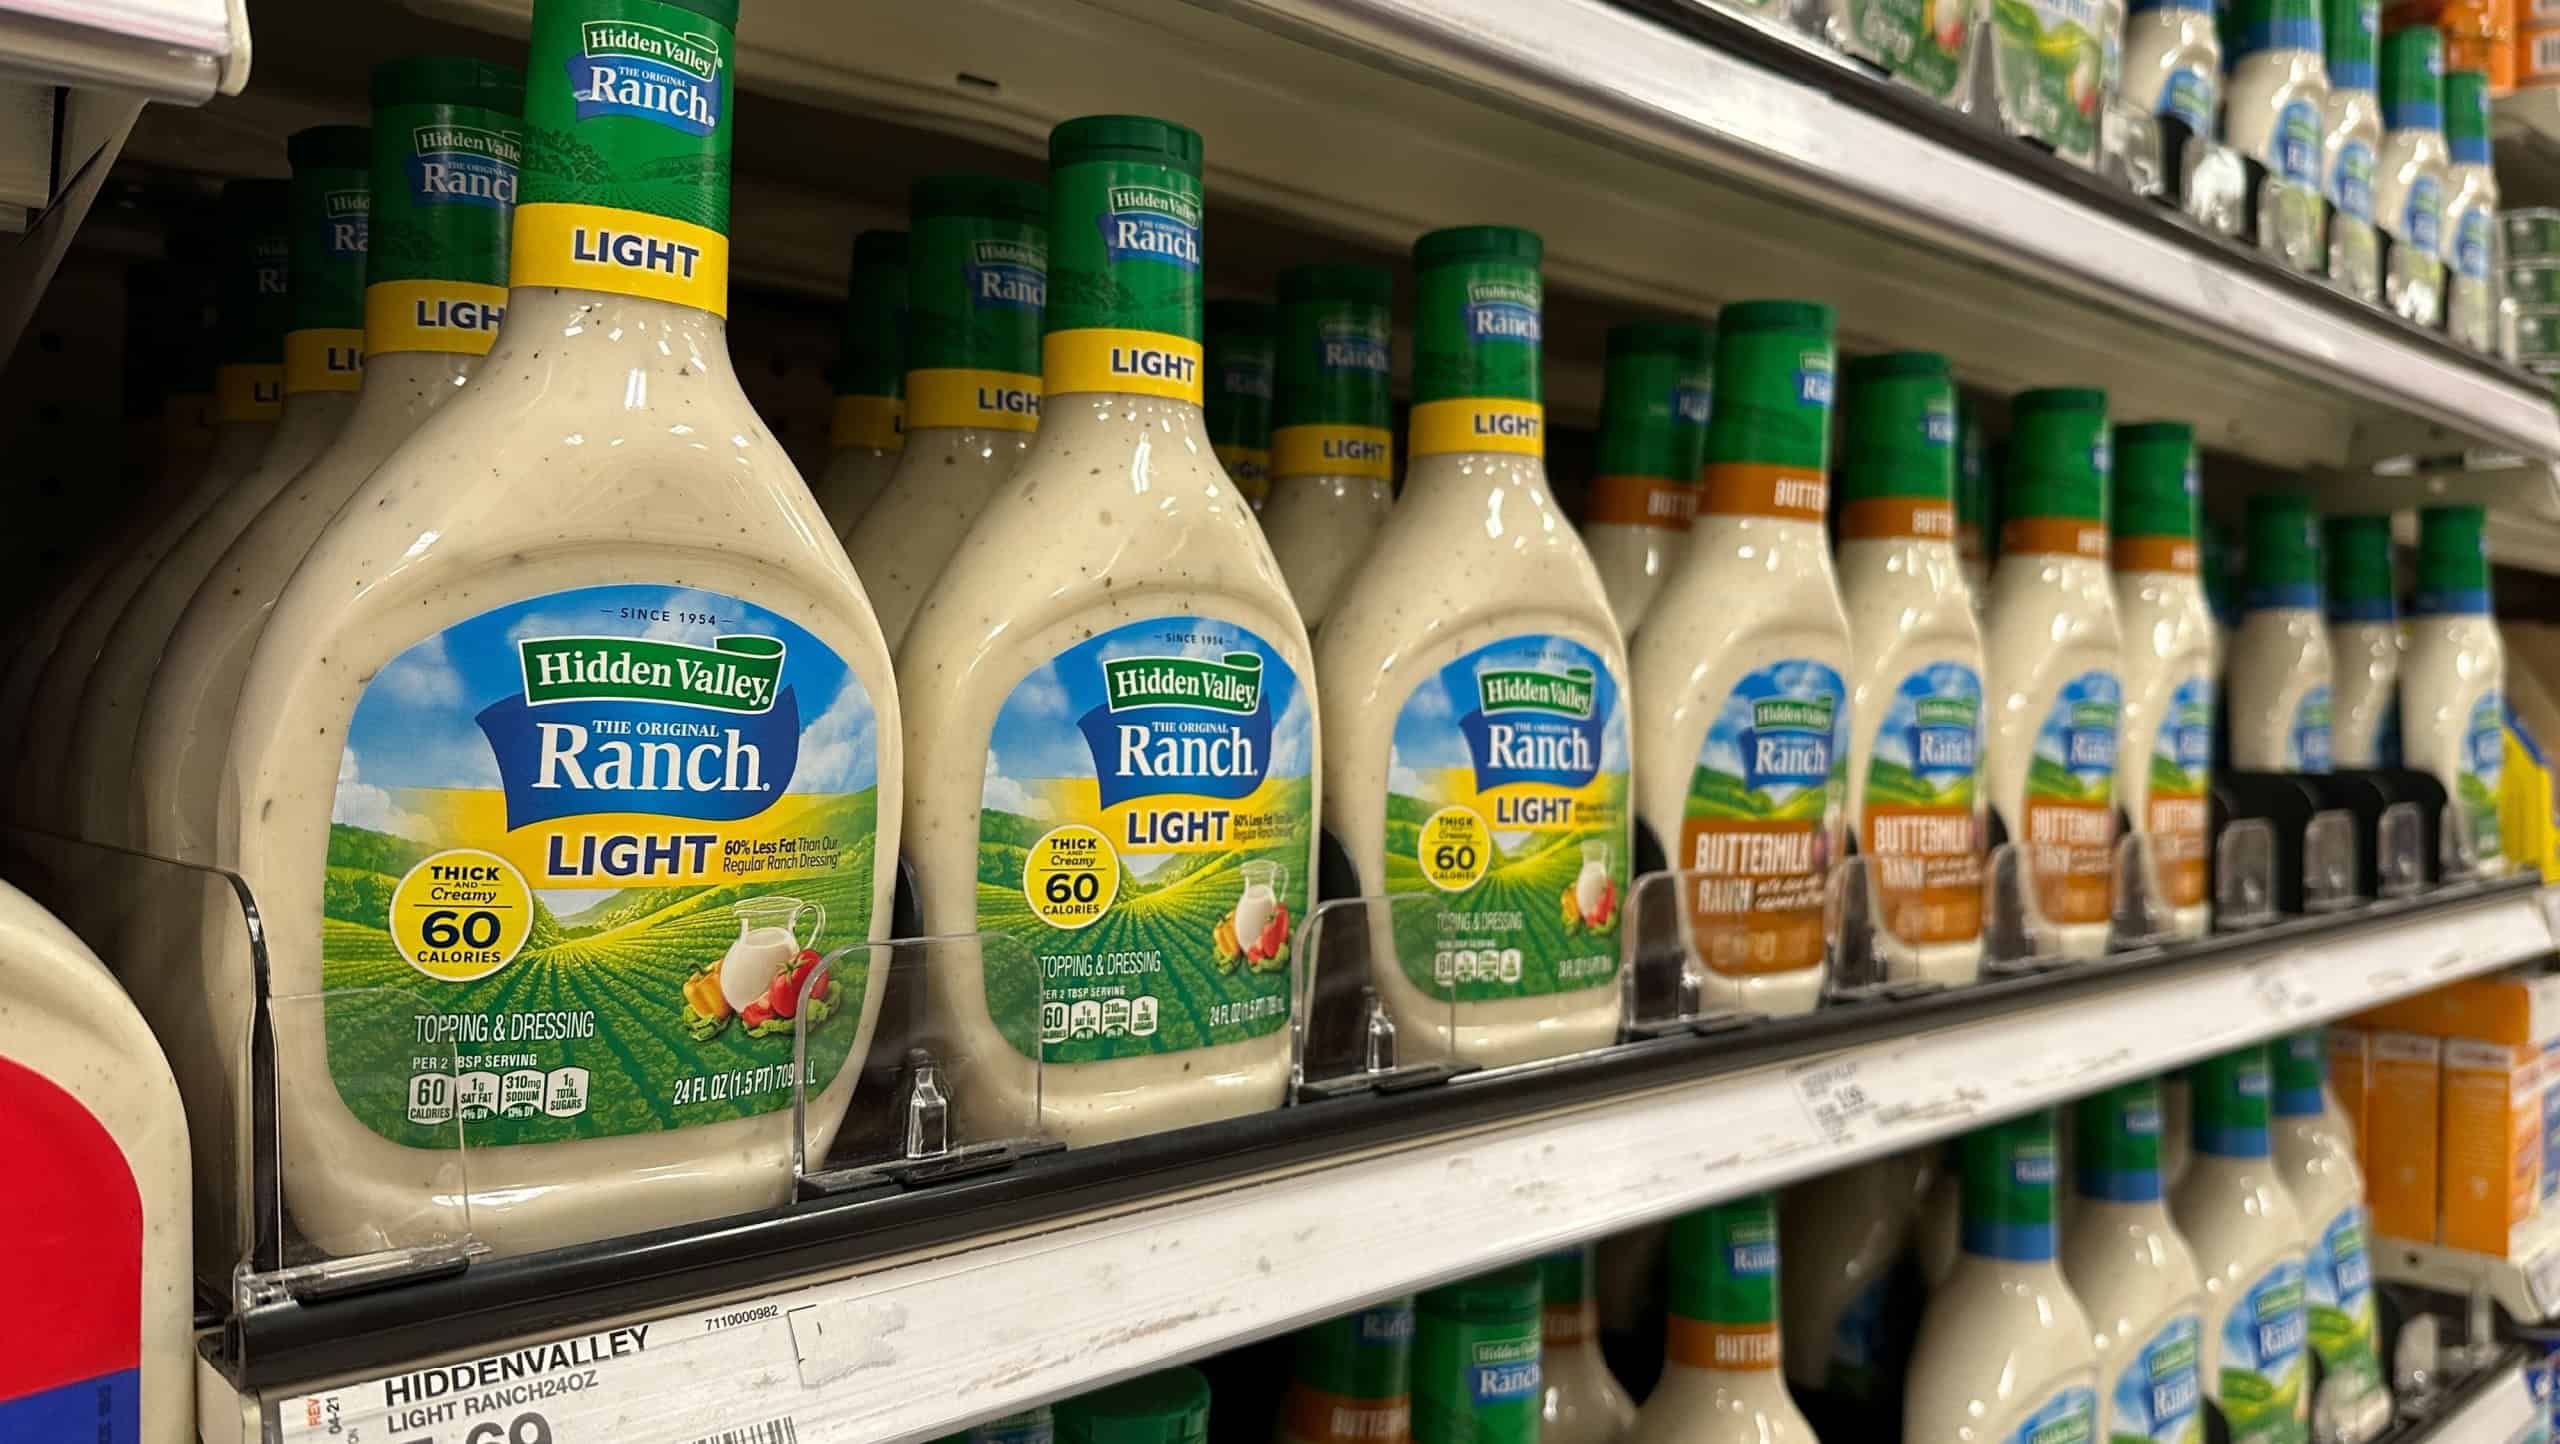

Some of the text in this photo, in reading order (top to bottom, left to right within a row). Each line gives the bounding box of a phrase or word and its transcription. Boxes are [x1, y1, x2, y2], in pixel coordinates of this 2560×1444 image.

[589, 29, 713, 76] Hidden Valley
[618, 65, 688, 88] THE ORIGINAL
[588, 65, 711, 126] Ranch
[421, 130, 520, 162] Hidden Valle
[1116, 191, 1169, 211] Hidden
[573, 228, 700, 278] LIGHT
[1115, 219, 1197, 264] Ranch
[416, 299, 506, 331] LIGH
[1111, 347, 1196, 384] LIGHT
[978, 387, 1041, 415] LIGH
[1473, 412, 1539, 439] LIGHT
[620, 607, 717, 626] SINCE 1954
[535, 650, 769, 706] Hidden Valley
[1115, 667, 1255, 709] Hidden Valley
[1486, 676, 1588, 713] Hidden Valley
[592, 719, 720, 738] THE ORIGINAL
[1152, 721, 1230, 734] THE ORIGINAL
[532, 721, 763, 792] Ranch
[1115, 725, 1252, 777] Ranch
[1488, 723, 1592, 771] Ranch
[1755, 736, 1827, 775] Ranch
[1438, 816, 1474, 827] THICK
[1496, 796, 1573, 825] LIGHT
[1127, 810, 1231, 845] LIGHT
[545, 834, 719, 879] LIGHT
[724, 835, 840, 856] 60% Less Fat Than Our
[1050, 838, 1097, 850] THICK
[1434, 844, 1476, 871] 60
[430, 866, 500, 881] THICK
[723, 856, 766, 876] Regular
[767, 855, 798, 870] Ranch
[1050, 855, 1096, 868] Creamy
[431, 886, 497, 905] Creamy
[453, 881, 478, 889] AND
[1045, 873, 1099, 904] 60
[1042, 904, 1100, 915] CALORIES
[421, 910, 502, 950] 60
[416, 950, 502, 963] CALORIES
[1040, 950, 1161, 978] TOPPING & DRESSING
[413, 1010, 596, 1043] TOPPING & DRESSING
[1043, 1006, 1064, 1029] 60
[412, 1053, 538, 1070] PER 2 BSP SERVING
[417, 1077, 447, 1107] 60
[504, 1075, 542, 1090] 310mg
[504, 1090, 540, 1102] SODIUM
[555, 1088, 578, 1099] TOTAL
[672, 1079, 690, 1106] 24
[692, 1076, 707, 1103] FL
[710, 1073, 729, 1100] OZ
[753, 1063, 774, 1094] PT)
[775, 1062, 795, 1089] 709
[460, 1091, 493, 1105] SAT FAT
[550, 1098, 583, 1111] SUGARS
[410, 1107, 451, 1120] CALORIES
[704, 1304, 779, 1331] 7110000982
[384, 1324, 650, 1408] HIDDENVALLEY
[307, 1398, 321, 1427] REV
[387, 1401, 457, 1434] LIGHT
[463, 1369, 600, 1417] RANCH24OZ
